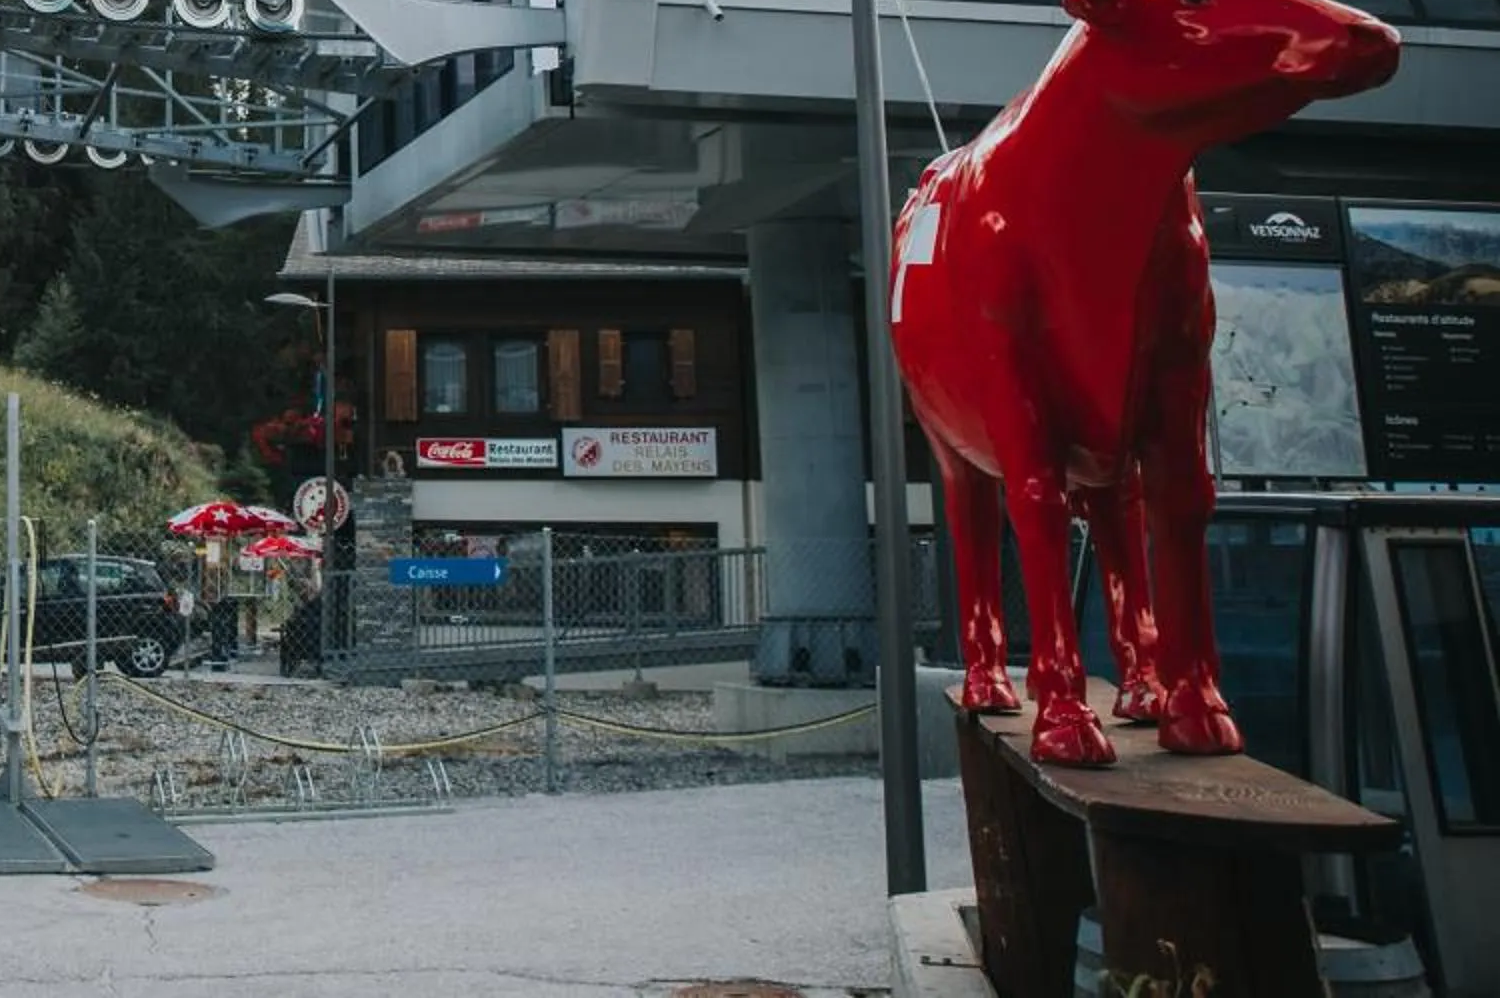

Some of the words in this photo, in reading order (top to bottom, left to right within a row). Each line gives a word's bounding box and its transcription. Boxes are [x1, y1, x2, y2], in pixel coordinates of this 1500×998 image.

[1249, 224, 1322, 239] VEYSONNAZ
[610, 431, 709, 444] RESTAURANT
[427, 442, 473, 459] Coca-Cola
[489, 443, 553, 456] Restaurant
[634, 445, 688, 459] RELAIS
[612, 460, 644, 473] DES
[651, 460, 711, 473] MAYENS
[407, 565, 449, 580] Caisse
